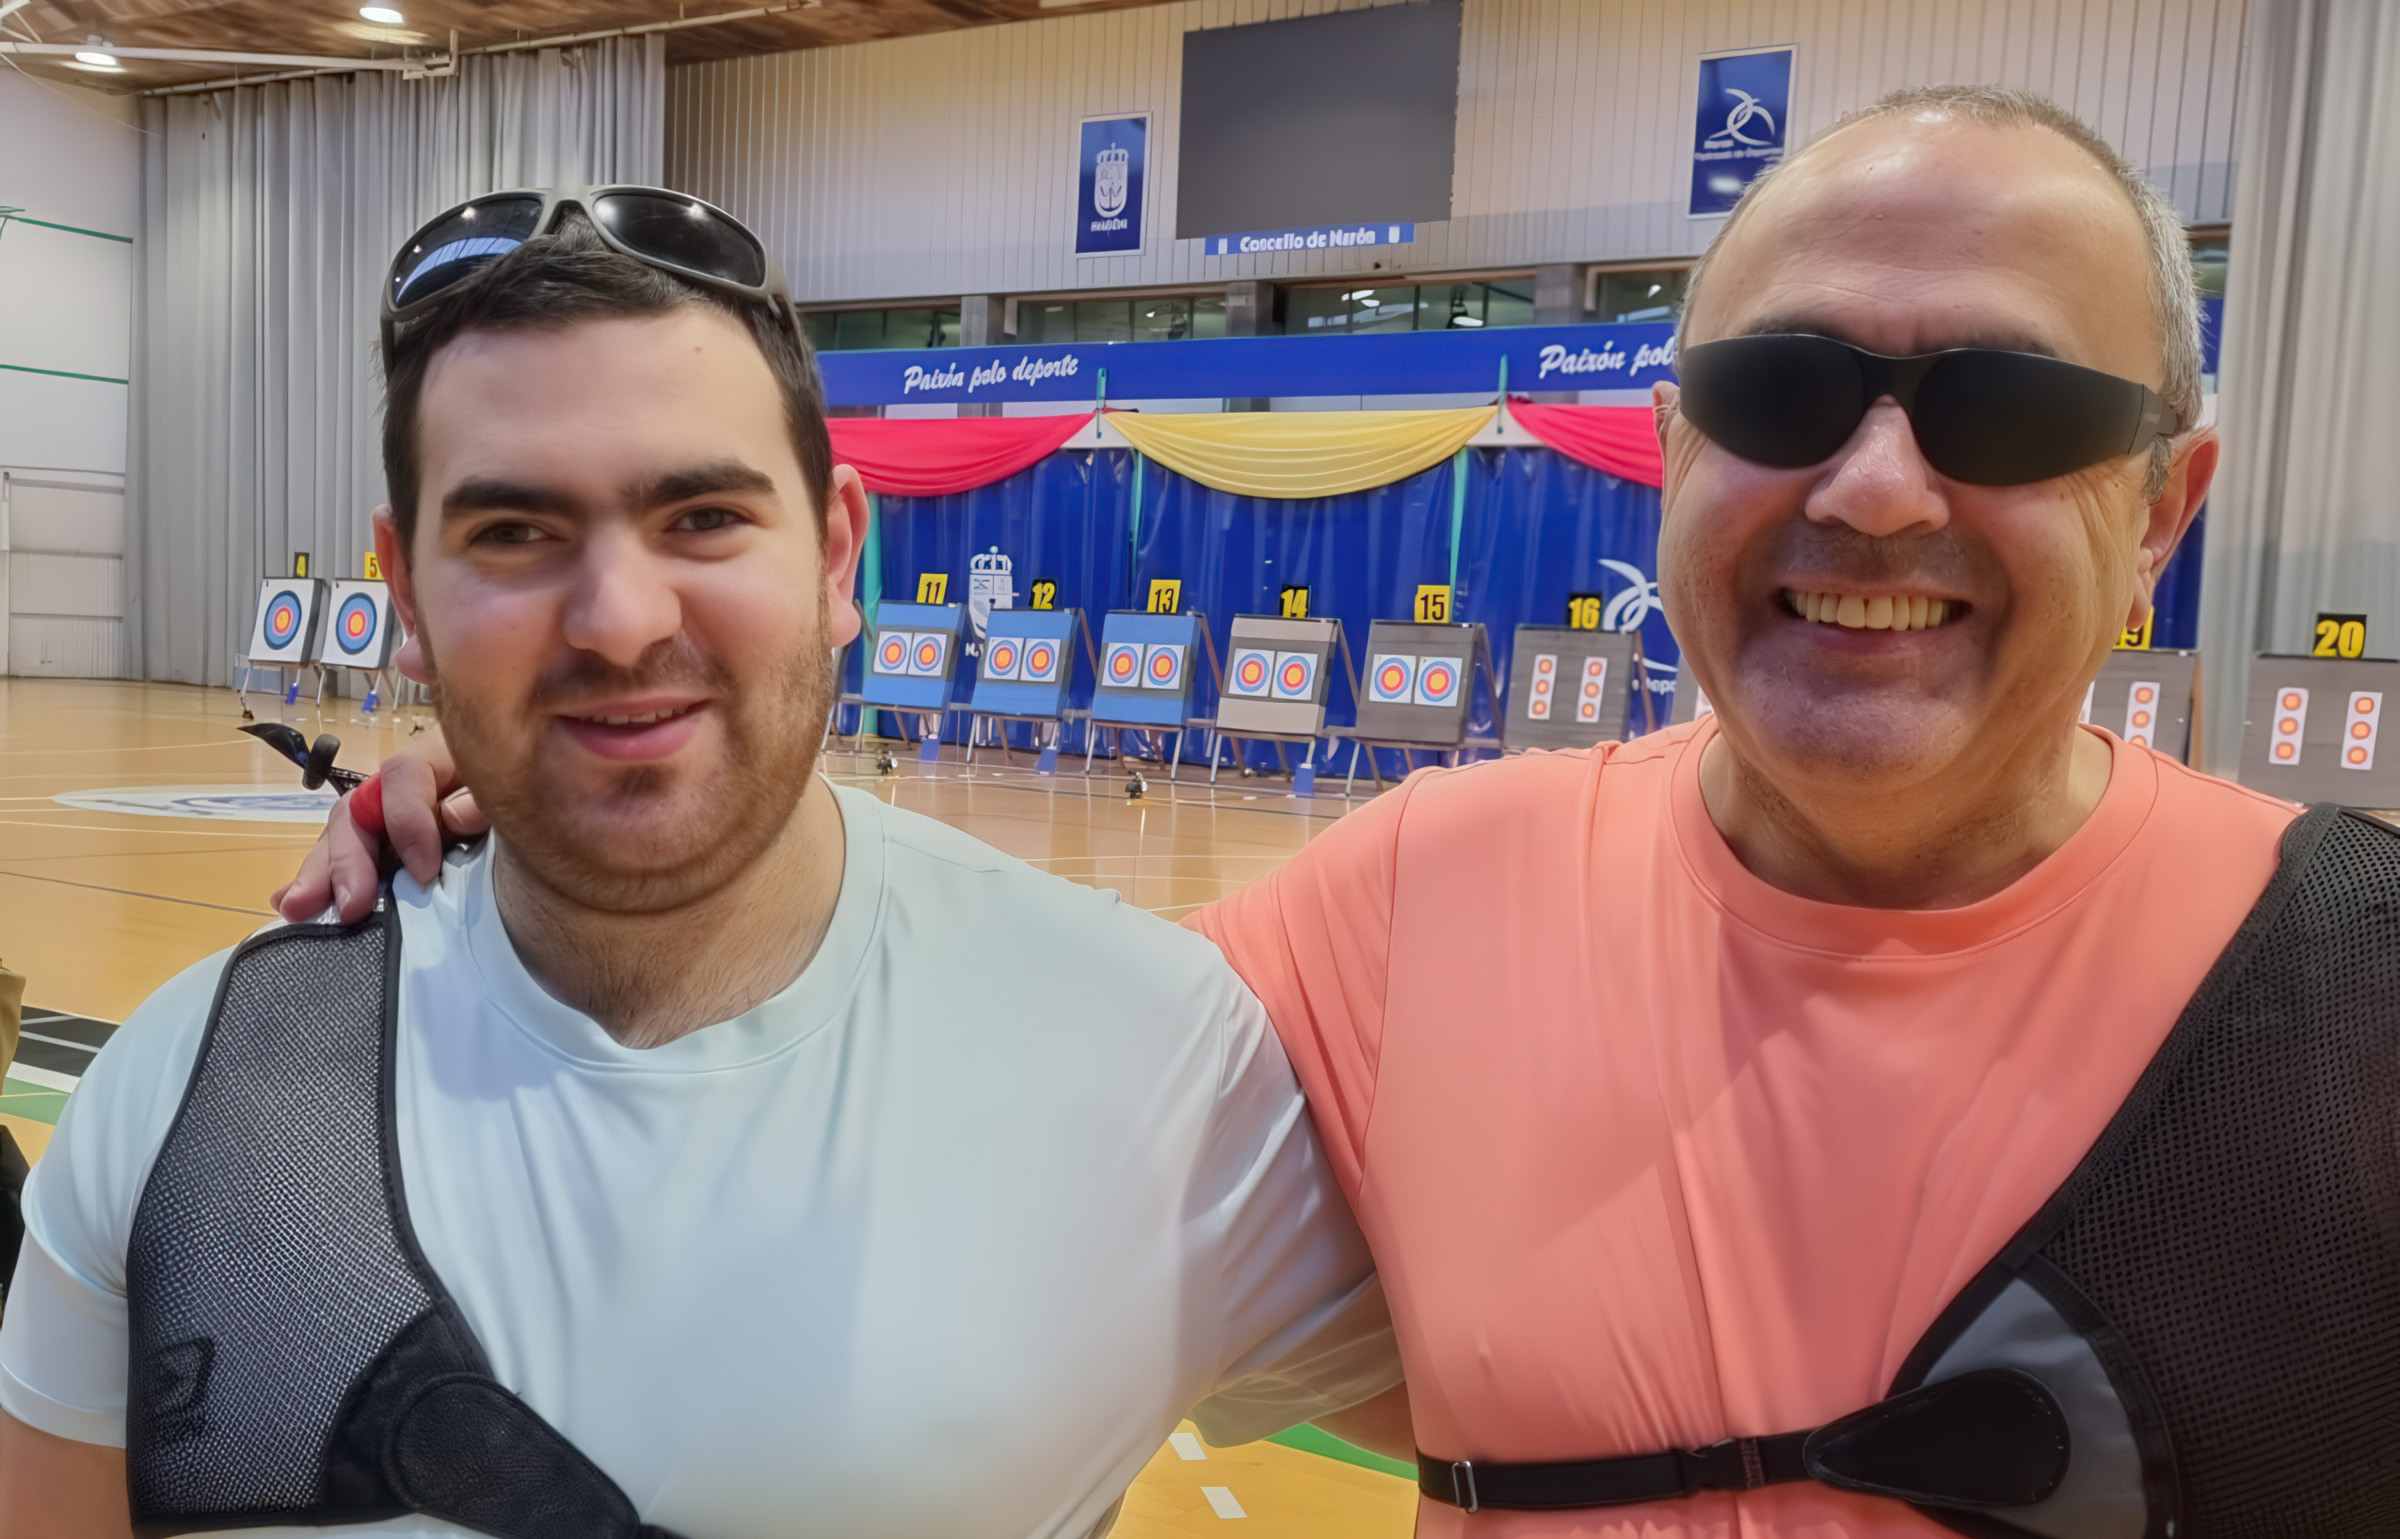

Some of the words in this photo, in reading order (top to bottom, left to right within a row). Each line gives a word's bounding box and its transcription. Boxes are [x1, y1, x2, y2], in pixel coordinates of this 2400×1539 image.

[1306, 231, 1327, 248] de
[1538, 340, 1626, 379] Paixón
[1629, 335, 1677, 376] pol
[968, 359, 1007, 393] polo
[1012, 354, 1079, 387] deporte
[925, 581, 941, 604] 11
[1032, 582, 1056, 610] 12
[1154, 588, 1174, 613] 13
[1281, 588, 1308, 618] 14
[1420, 594, 1445, 620] 15
[1568, 597, 1601, 630] 16
[2312, 619, 2365, 658] 20
